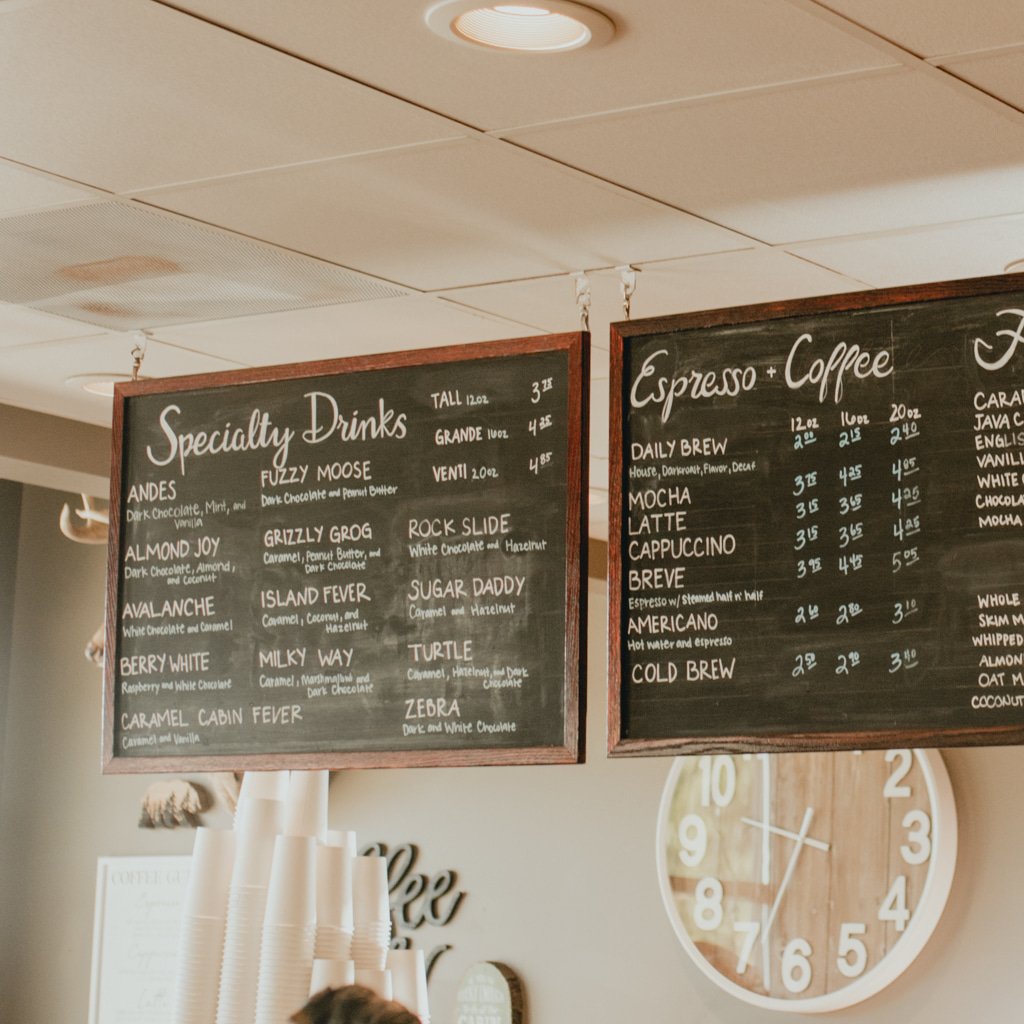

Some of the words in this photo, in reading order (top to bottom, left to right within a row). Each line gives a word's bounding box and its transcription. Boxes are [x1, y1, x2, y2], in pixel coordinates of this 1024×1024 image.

[629, 348, 756, 424] Espresso
[784, 333, 894, 404] Coffee
[431, 389, 462, 409] TALL
[791, 416, 819, 432] 12oz
[841, 412, 869, 426] 16oz
[889, 404, 920, 421] 20oz
[974, 413, 1011, 430] JAVA
[147, 404, 295, 476] Specialty
[302, 392, 407, 444] Drinks
[435, 427, 483, 445] GRANDE
[631, 441, 676, 461] DAILY
[680, 437, 727, 456] BREW
[260, 465, 308, 488] FUZZY
[317, 461, 372, 482] MOOSE
[432, 463, 467, 482] VENTI
[978, 472, 1019, 489] WHITE
[127, 480, 177, 503] ANDES
[629, 487, 691, 511] MOCHA
[409, 518, 455, 539] ROCK
[462, 513, 510, 536] SLIDE
[628, 511, 686, 536] LATTE
[979, 514, 1022, 528] MOCHA
[264, 526, 323, 548] GRIZZLY
[329, 522, 372, 543] GROG
[125, 539, 190, 562] ALMOND
[194, 536, 220, 558] JOY
[410, 543, 438, 557] White
[441, 541, 485, 556] Chocolate
[487, 542, 499, 550] and
[505, 539, 547, 551] Hazelnut
[628, 534, 736, 561] CAPPUCCINO
[408, 579, 467, 600] SUGAR
[473, 576, 525, 596] DADDY
[629, 567, 686, 591] BREVE
[122, 596, 215, 619] AVALANCHE
[261, 587, 319, 609] ISLAND
[324, 583, 371, 603] FEVER
[978, 593, 1019, 608] WHOLE
[628, 612, 719, 634] AMERICANO
[979, 613, 1009, 627] SKIM
[407, 641, 472, 661] TURTLE
[628, 638, 645, 651] Hot
[647, 637, 675, 649] water
[676, 636, 692, 648] and
[694, 636, 732, 650] espresso
[972, 632, 1023, 647] WHIPPED
[120, 653, 166, 676] BERRY
[170, 652, 210, 672] WHITE
[259, 648, 306, 668] MILKY
[318, 648, 353, 667] WAY
[632, 660, 678, 684] COLD
[686, 658, 736, 681] BREW
[978, 672, 1007, 687] OAT
[405, 698, 460, 719] ZEBRA
[971, 694, 1024, 708] COCONUT
[121, 708, 189, 730] CARAMEL
[198, 708, 243, 727] CABIN
[252, 705, 303, 724] FEVER
[699, 755, 736, 807] 10
[884, 749, 912, 798] 2
[679, 814, 706, 867] 9
[901, 810, 931, 864] 3
[693, 877, 723, 930] 8
[878, 875, 910, 931] 4
[734, 922, 760, 974] 7
[837, 923, 866, 977] 5
[781, 938, 813, 992] 6
